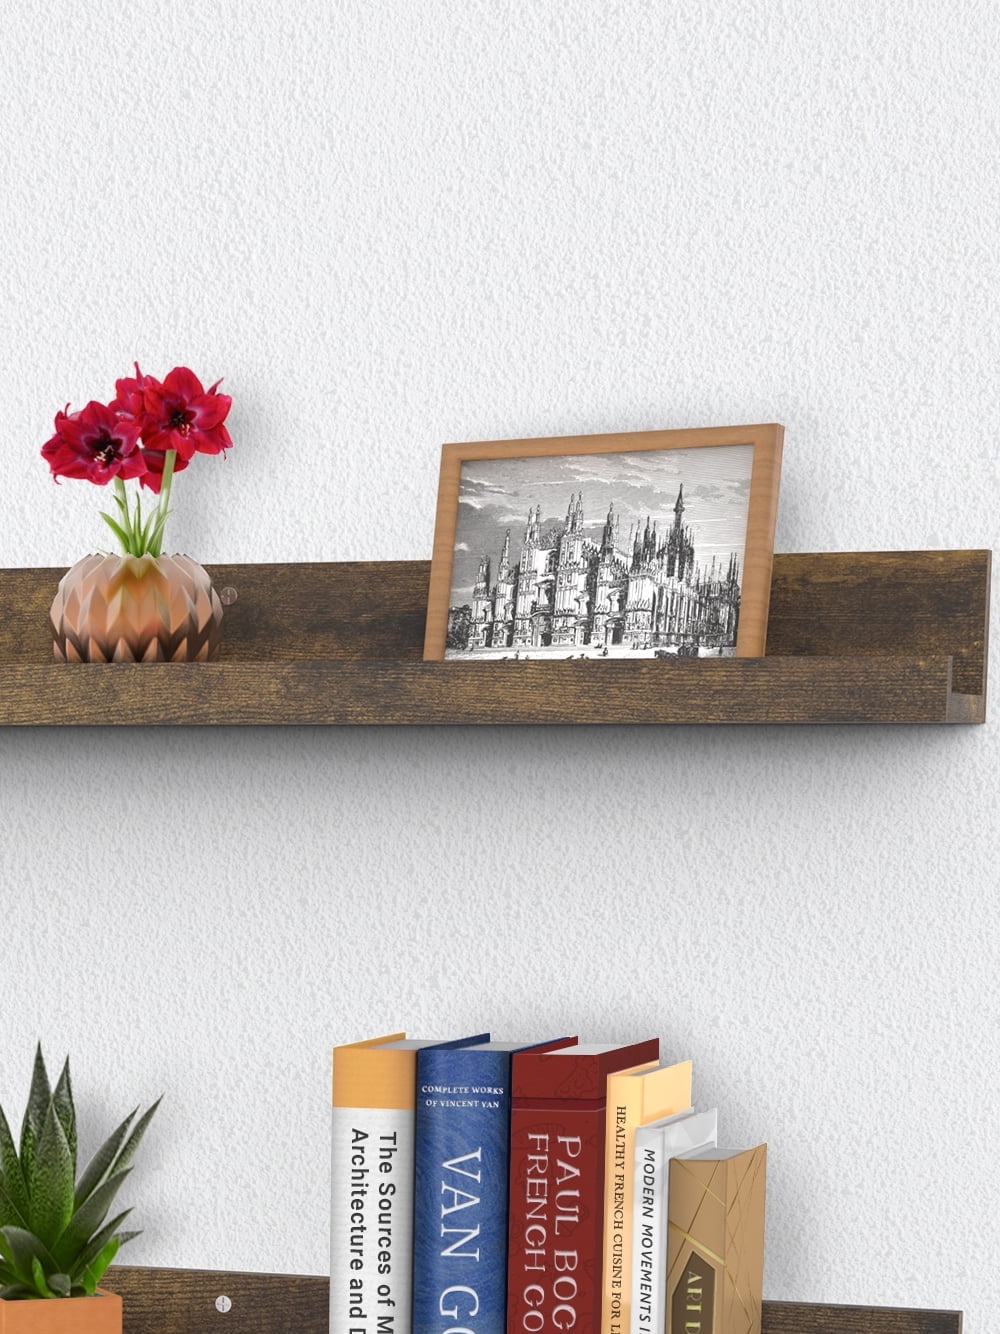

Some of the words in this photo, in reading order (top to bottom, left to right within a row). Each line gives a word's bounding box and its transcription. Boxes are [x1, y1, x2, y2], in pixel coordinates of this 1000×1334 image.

[422, 1086, 470, 1094] COMPLETE
[472, 1086, 504, 1094] WORKS
[379, 1132, 396, 1174] The
[615, 1106, 627, 1170] HEALTHY
[350, 1129, 370, 1270] Architecture
[440, 1146, 482, 1262] VAN
[524, 1133, 549, 1272] FRENCH
[553, 1135, 582, 1236] PAUL
[613, 1174, 625, 1230] FRENCH
[642, 1149, 656, 1218] MODERN
[378, 1184, 396, 1276] Sources
[612, 1234, 624, 1288] CUISINE
[639, 1224, 653, 1322] MOVEMENTS
[348, 1280, 369, 1319] and
[377, 1285, 396, 1309] of
[610, 1292, 622, 1319] FOR
[686, 1271, 703, 1312] ART
